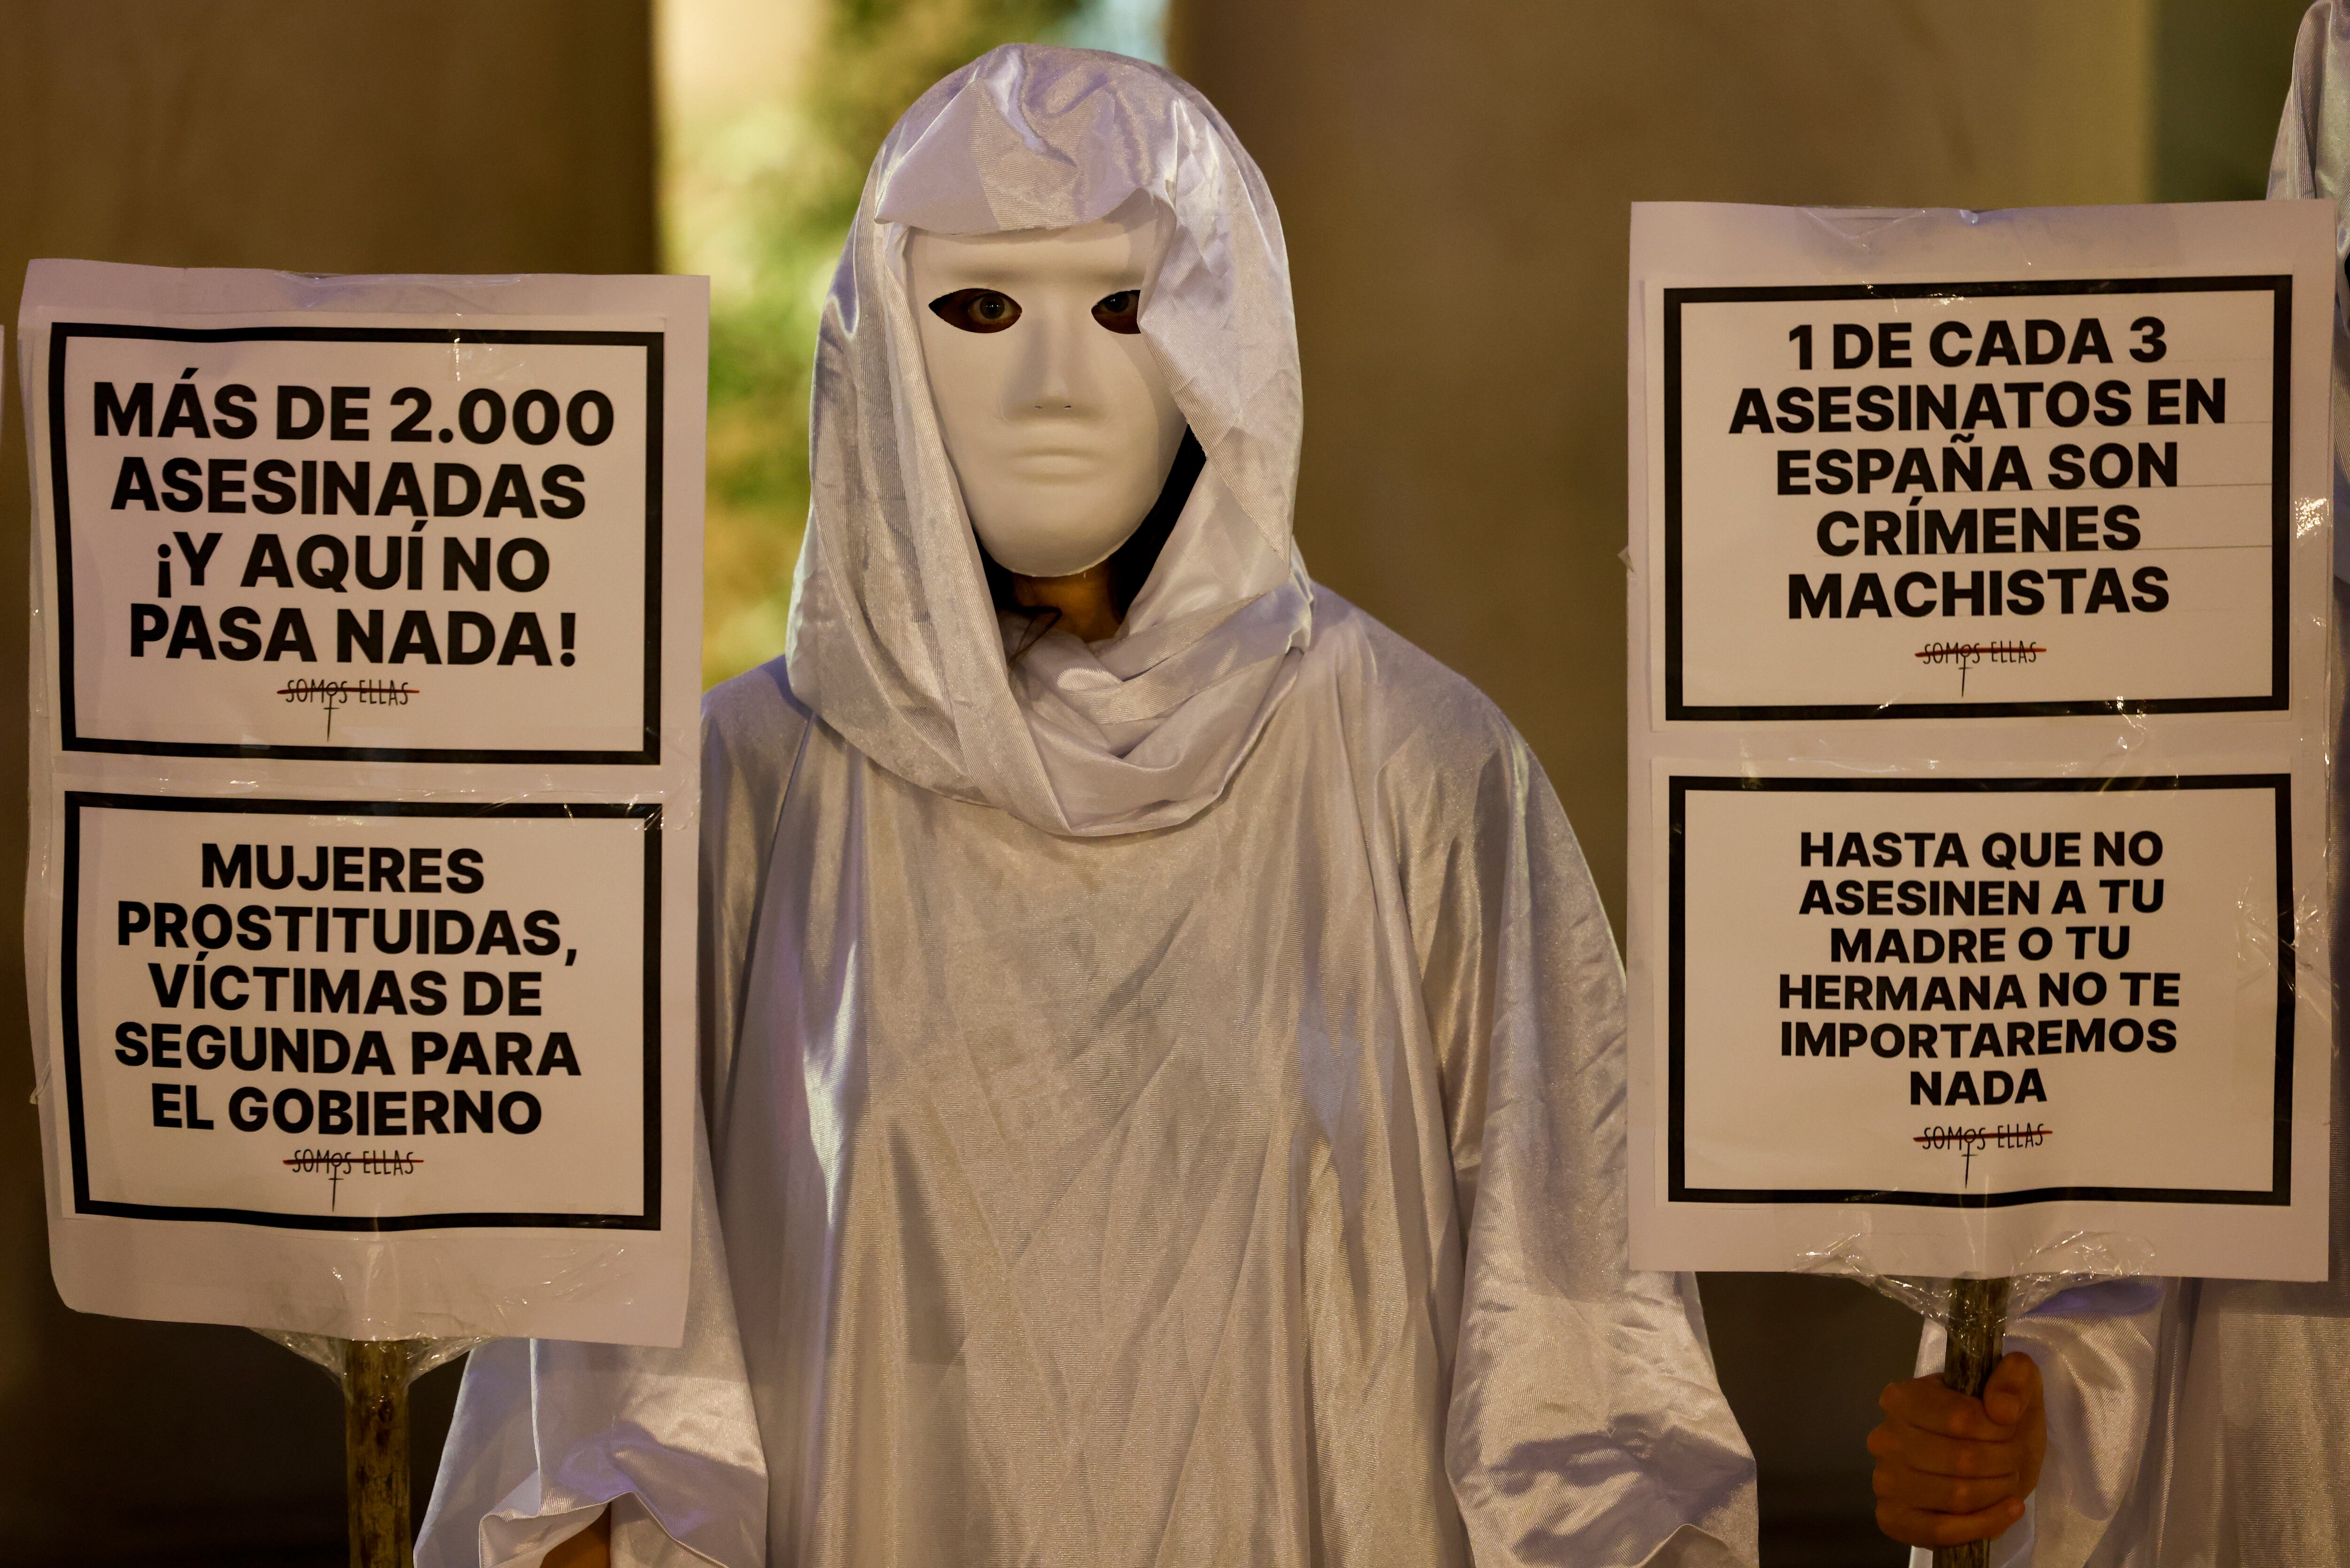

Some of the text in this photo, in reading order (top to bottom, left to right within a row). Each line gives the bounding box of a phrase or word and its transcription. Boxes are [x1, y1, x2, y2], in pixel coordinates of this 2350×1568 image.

[1788, 316, 2167, 371] 1 DE CADA 3
[93, 367, 615, 447] MÁS DE 2.000
[1728, 377, 2226, 435] ASESINATOS EN
[110, 456, 586, 520] ASESINADAS
[1777, 432, 2178, 496] ESPAÑA SON
[1816, 495, 2141, 557] CRÍMENES
[157, 519, 550, 599] ¡Y AQUÍ NO
[1788, 565, 2170, 620] MACHISTAS
[130, 602, 576, 668] PASA NADA!
[1923, 640, 2037, 664] SOMOS ELLAS
[286, 679, 408, 706] SOMOS ELLAS
[201, 843, 485, 895] MUJERES
[1800, 830, 2163, 871] HASTA QUE NO
[1798, 878, 2165, 917] ASESINEN A TU
[118, 900, 577, 967] PROSTITUIDAS,
[1830, 925, 2131, 964] MADRE O TU
[147, 951, 542, 1017] VÍCTIMAS DE
[1779, 971, 2181, 1012] HERMANA NO TE
[114, 1021, 582, 1077] SEGUNDA PARA
[1781, 1017, 2177, 1059] IMPORTAREMOS
[151, 1082, 542, 1137] EL GOBIERNO
[1910, 1067, 2048, 1107] NADA
[292, 1149, 414, 1176] SOMOS ELLAS
[1922, 1123, 2044, 1150] SOMOS ELLAS
